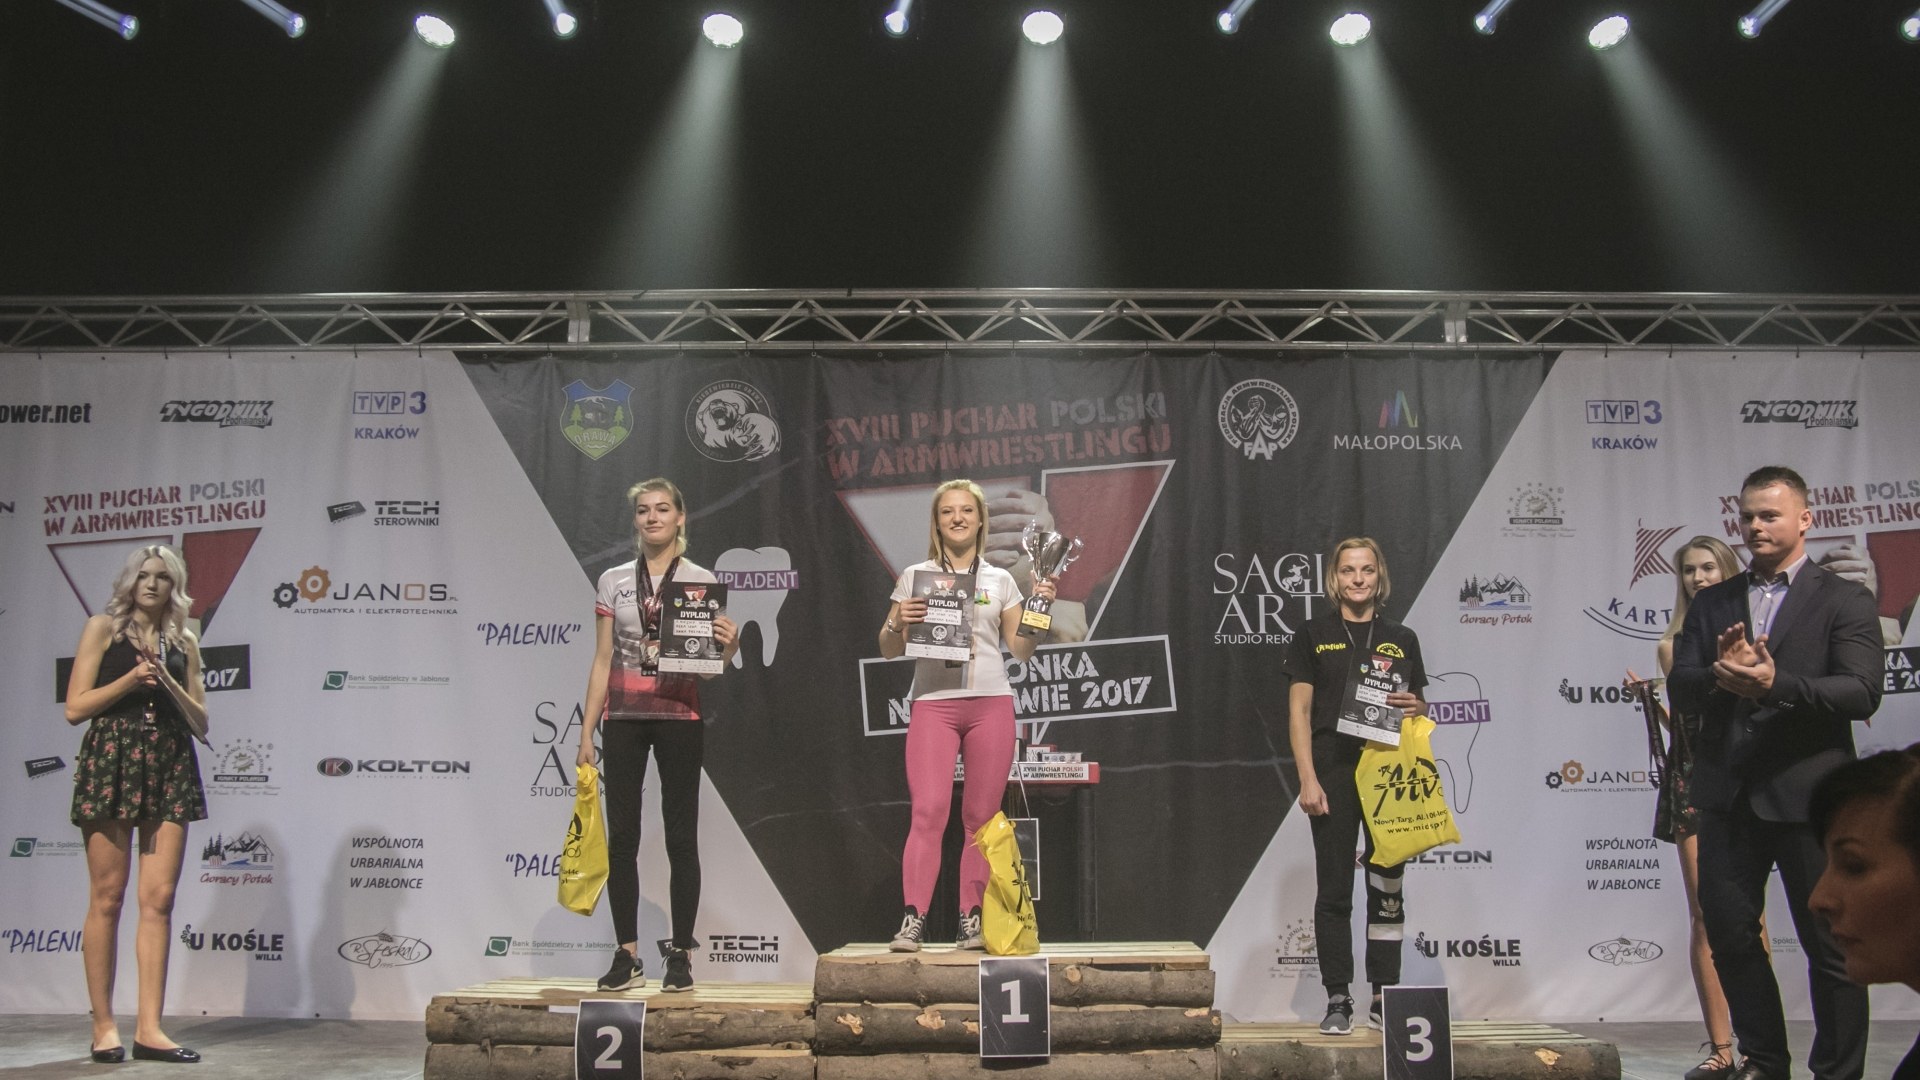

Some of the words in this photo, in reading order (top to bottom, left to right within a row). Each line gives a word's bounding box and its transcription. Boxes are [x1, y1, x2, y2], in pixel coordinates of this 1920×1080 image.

[158, 400, 274, 421] TYGODNIK
[355, 393, 404, 413] TVP
[409, 391, 427, 414] 3
[0, 403, 92, 424] ower.net
[825, 414, 900, 446] XVIII
[911, 402, 1039, 440] PUCHAR
[1050, 391, 1167, 428] POLSKI
[1587, 401, 1638, 423] TVP
[1643, 400, 1663, 425] 3
[1741, 400, 1857, 422] TYGODNIK
[354, 425, 420, 440] KRAKÓW
[574, 431, 617, 447] ORAWA
[1243, 430, 1279, 460] FAP
[1333, 434, 1463, 450] MAŁOPOLSKA
[1591, 434, 1658, 450] KRAKÓW
[828, 449, 860, 480] W
[870, 423, 1173, 478] ARMWRESTLINGU
[44, 493, 93, 515] XVIII
[100, 486, 182, 511] PUCHAR
[189, 478, 266, 502] POLSKI
[1864, 479, 1920, 501] POLS
[374, 500, 440, 515] TECH
[44, 516, 65, 537] W
[71, 500, 267, 535] ARMWRESTLINGU
[373, 517, 440, 527] STEROWNIKI
[1213, 553, 1326, 595] SAGI
[294, 607, 355, 615] AUTOMATYKA
[365, 607, 459, 615] ELEKTROTECHNIKA
[928, 598, 959, 608] DYPLOM
[680, 610, 711, 620] DYPLOM
[1215, 593, 1327, 635] ART
[1502, 613, 1533, 625] Potok
[1608, 597, 1674, 626] KART
[1214, 633, 1262, 645] STUDIO
[348, 674, 367, 682] Bank
[1364, 677, 1394, 692] DYPLOM
[1080, 675, 1153, 710] 2017
[1569, 686, 1583, 703] U
[356, 759, 471, 773] KOŁTON
[1038, 765, 1061, 773] PUCHAR
[1373, 819, 1395, 827] Nowy
[1397, 815, 1415, 824] Targ,
[352, 836, 424, 850] WSPÓLNOTA
[1585, 837, 1659, 850] WSPÓLNOTA
[350, 857, 424, 870] URBARIALNA
[1585, 859, 1660, 870] URBARIALNA
[243, 873, 273, 885] Potok
[350, 877, 363, 889] W
[364, 877, 424, 890] JABŁONCE
[1587, 879, 1599, 890] W
[1600, 879, 1662, 890] JABŁONCE
[190, 933, 205, 951] U
[211, 929, 285, 951] KOŚLE
[512, 940, 530, 948] Bank
[532, 940, 575, 949] Spółdzielczy
[584, 940, 616, 949] Jabłonce
[708, 934, 779, 952] TECH
[1424, 940, 1440, 958] U
[1446, 934, 1522, 957] KOŚLE
[255, 953, 283, 961] WILLA
[708, 952, 780, 964] STEROWNIKI
[1492, 959, 1522, 967] WILLA
[1001, 979, 1030, 1024] 1
[1405, 1016, 1434, 1062] 3
[593, 1025, 623, 1070] 2
